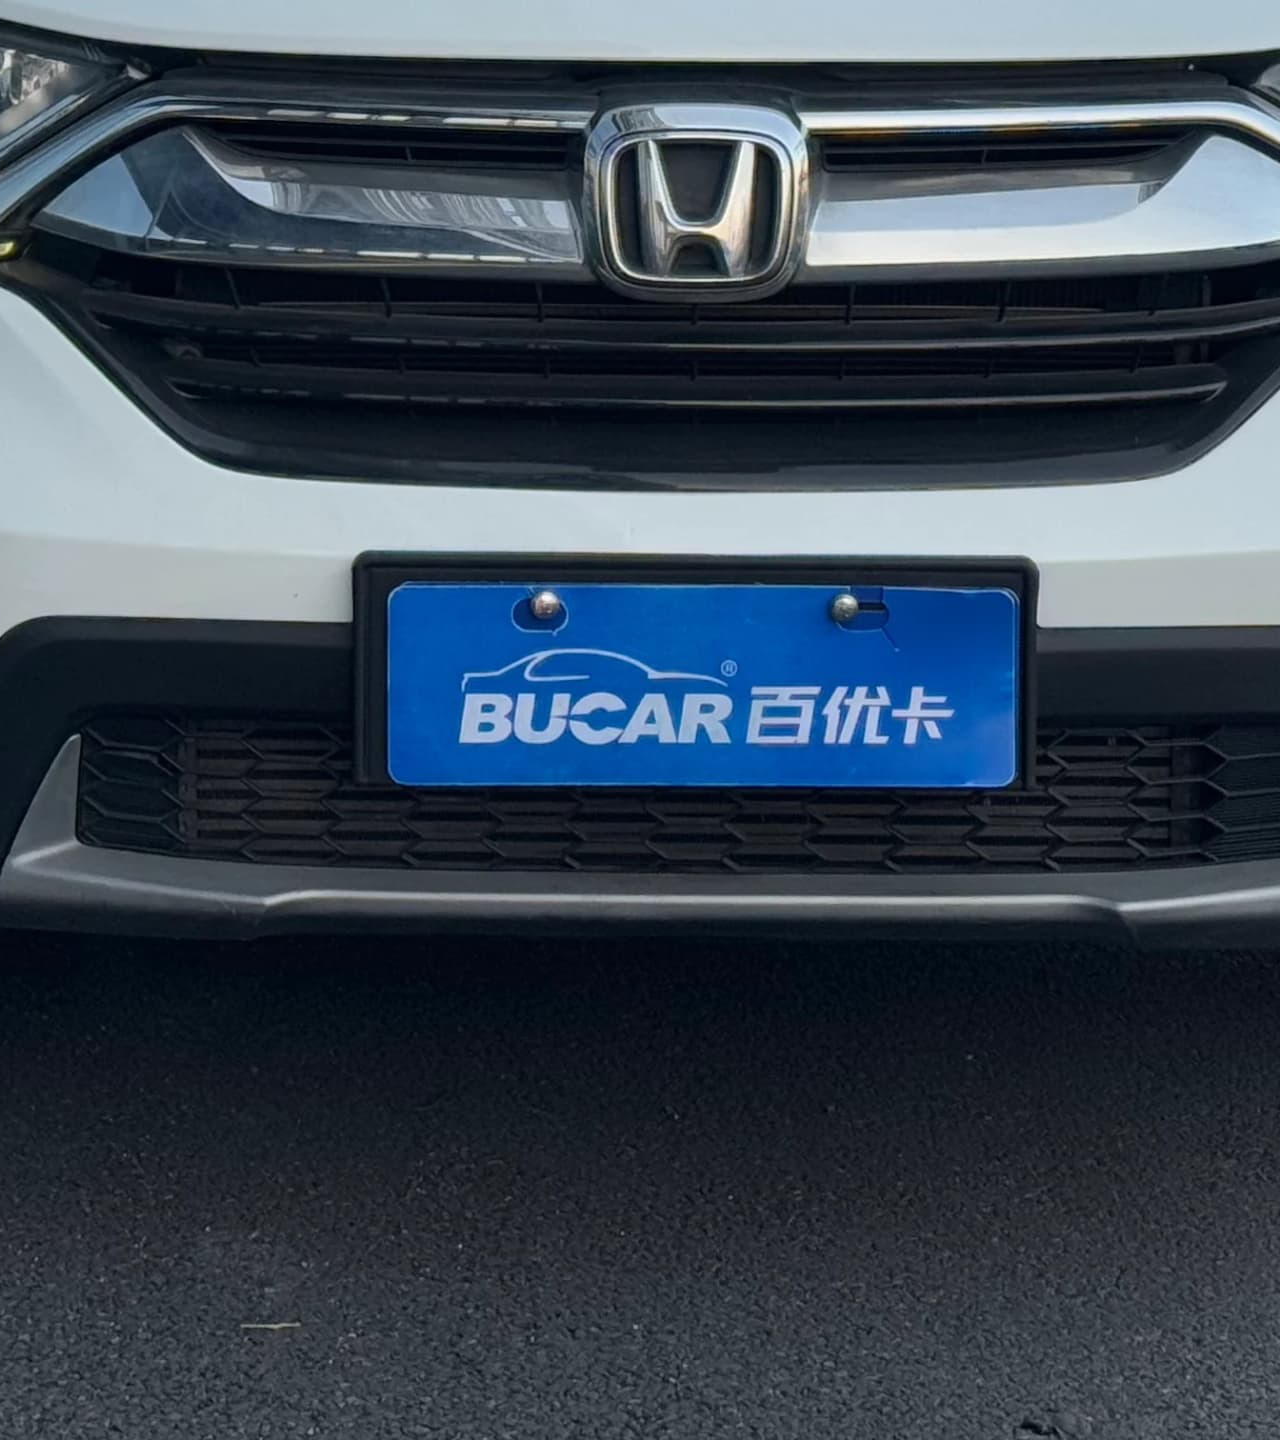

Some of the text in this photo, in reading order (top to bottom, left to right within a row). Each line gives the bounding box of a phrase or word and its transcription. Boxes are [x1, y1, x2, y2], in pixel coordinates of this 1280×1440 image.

[458, 685, 955, 746] BUCAR 百优卡
